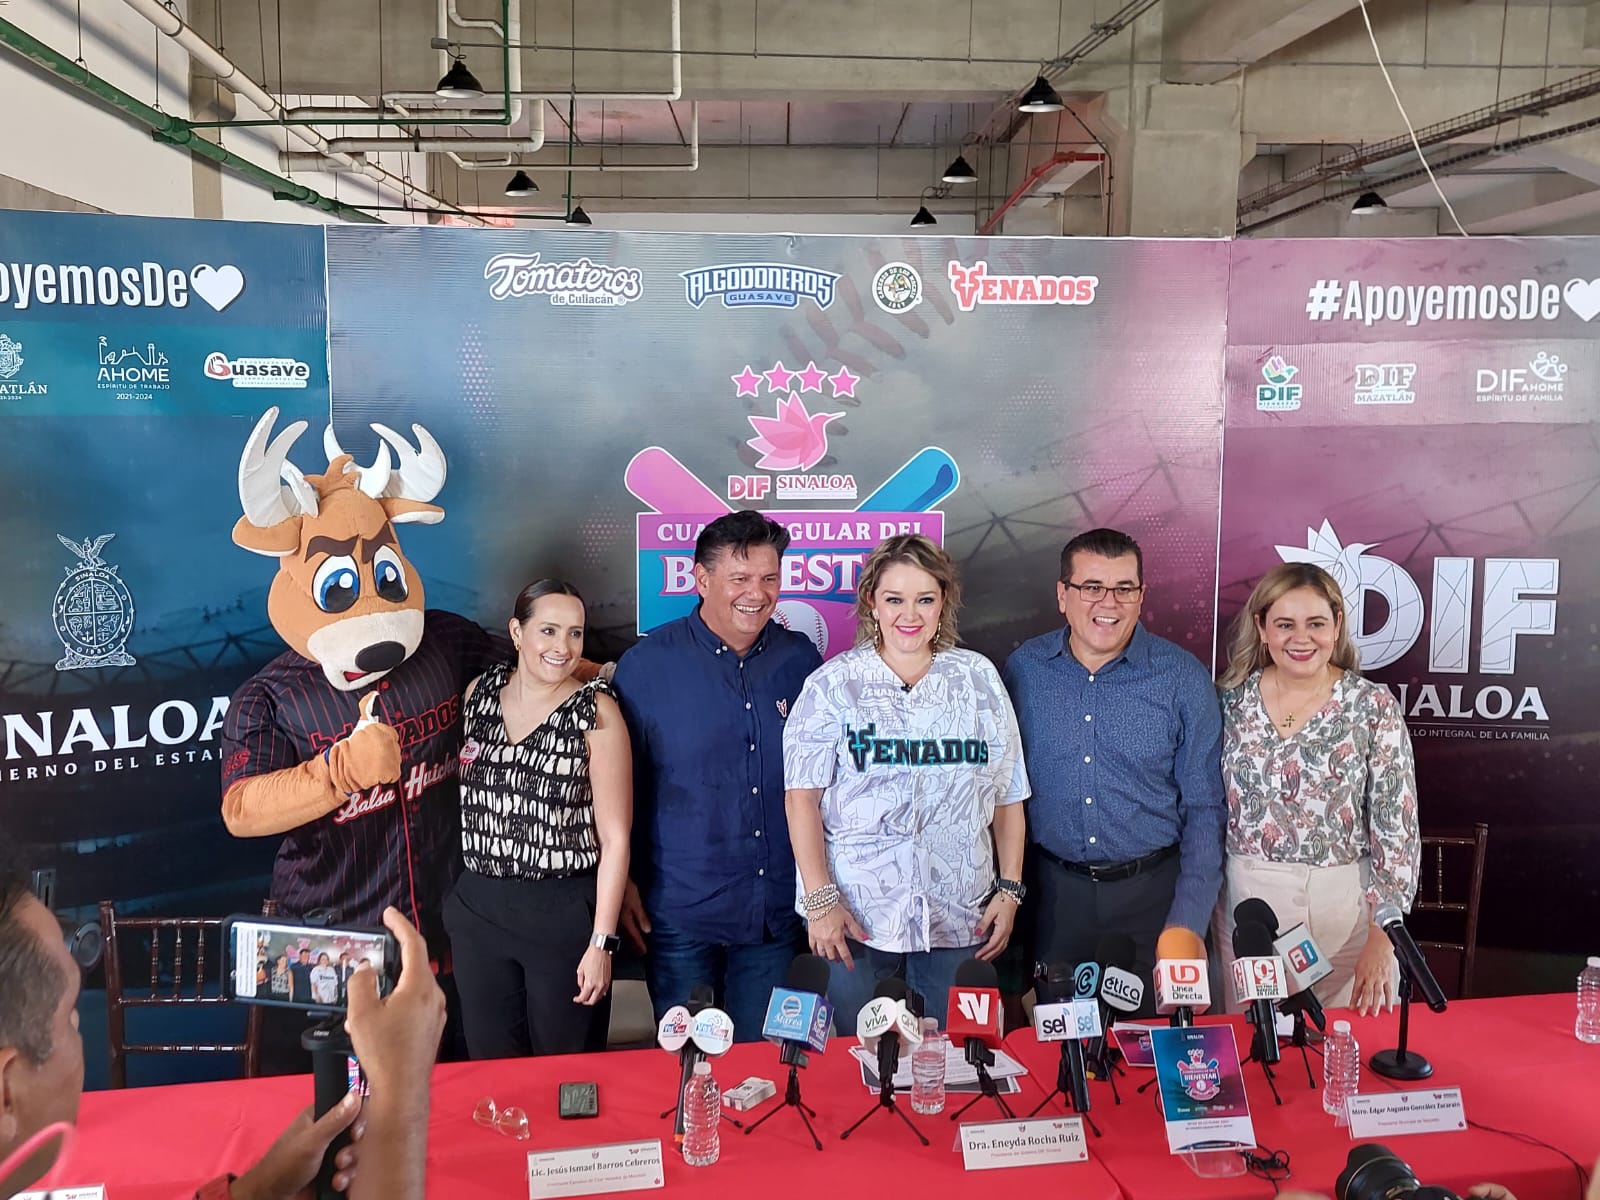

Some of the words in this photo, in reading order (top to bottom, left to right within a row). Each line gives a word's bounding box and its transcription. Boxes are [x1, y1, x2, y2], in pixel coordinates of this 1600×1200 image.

[484, 251, 642, 299] Tomateros
[952, 264, 1091, 307] VENADOS
[686, 264, 836, 308] ALGODONEROS
[552, 293, 566, 304] de
[568, 292, 613, 305] Culiacán
[728, 292, 793, 302] GUASAVE
[1306, 279, 1560, 326] #ApoyemosDe
[98, 367, 169, 382] AHOME
[207, 355, 307, 377] Guasave
[1357, 366, 1413, 387] DIF
[1476, 369, 1527, 392] DIF
[1521, 383, 1564, 392] AHOME
[1259, 386, 1300, 401] DIF
[1357, 392, 1412, 402] MAZATLÁN
[1476, 394, 1513, 402] ESPÍRITU
[731, 476, 769, 499] DIF
[778, 475, 855, 488] SINALOA
[879, 522, 921, 540] DEL
[74, 571, 110, 581] SINALOA
[1344, 554, 1560, 674] DIF
[1429, 729, 1476, 739] INTEGRAL
[1480, 731, 1493, 739] DE
[1495, 731, 1508, 740] LA
[1510, 731, 1550, 741] FAMILIA
[846, 723, 989, 773] VENADOS
[0, 763, 78, 781] ERNO
[94, 757, 139, 772] DEL
[155, 747, 222, 766] ESTA
[333, 787, 396, 825] Salsa
[404, 751, 459, 801] Huicho
[1104, 976, 1140, 1001] ética
[1172, 991, 1203, 1001] Directa
[864, 1014, 888, 1028] VIVA
[1042, 1014, 1067, 1034] sel
[969, 1140, 990, 1150] Dra.
[992, 1136, 1026, 1149] Eneyda
[1028, 1133, 1057, 1146] Rocha
[1058, 1132, 1080, 1143] Ruiz
[531, 1168, 546, 1177] Lic.
[547, 1165, 568, 1177] Jesús
[569, 1163, 595, 1173] Ismael
[597, 1160, 623, 1170] Barros
[624, 1156, 660, 1167] Cebreros
